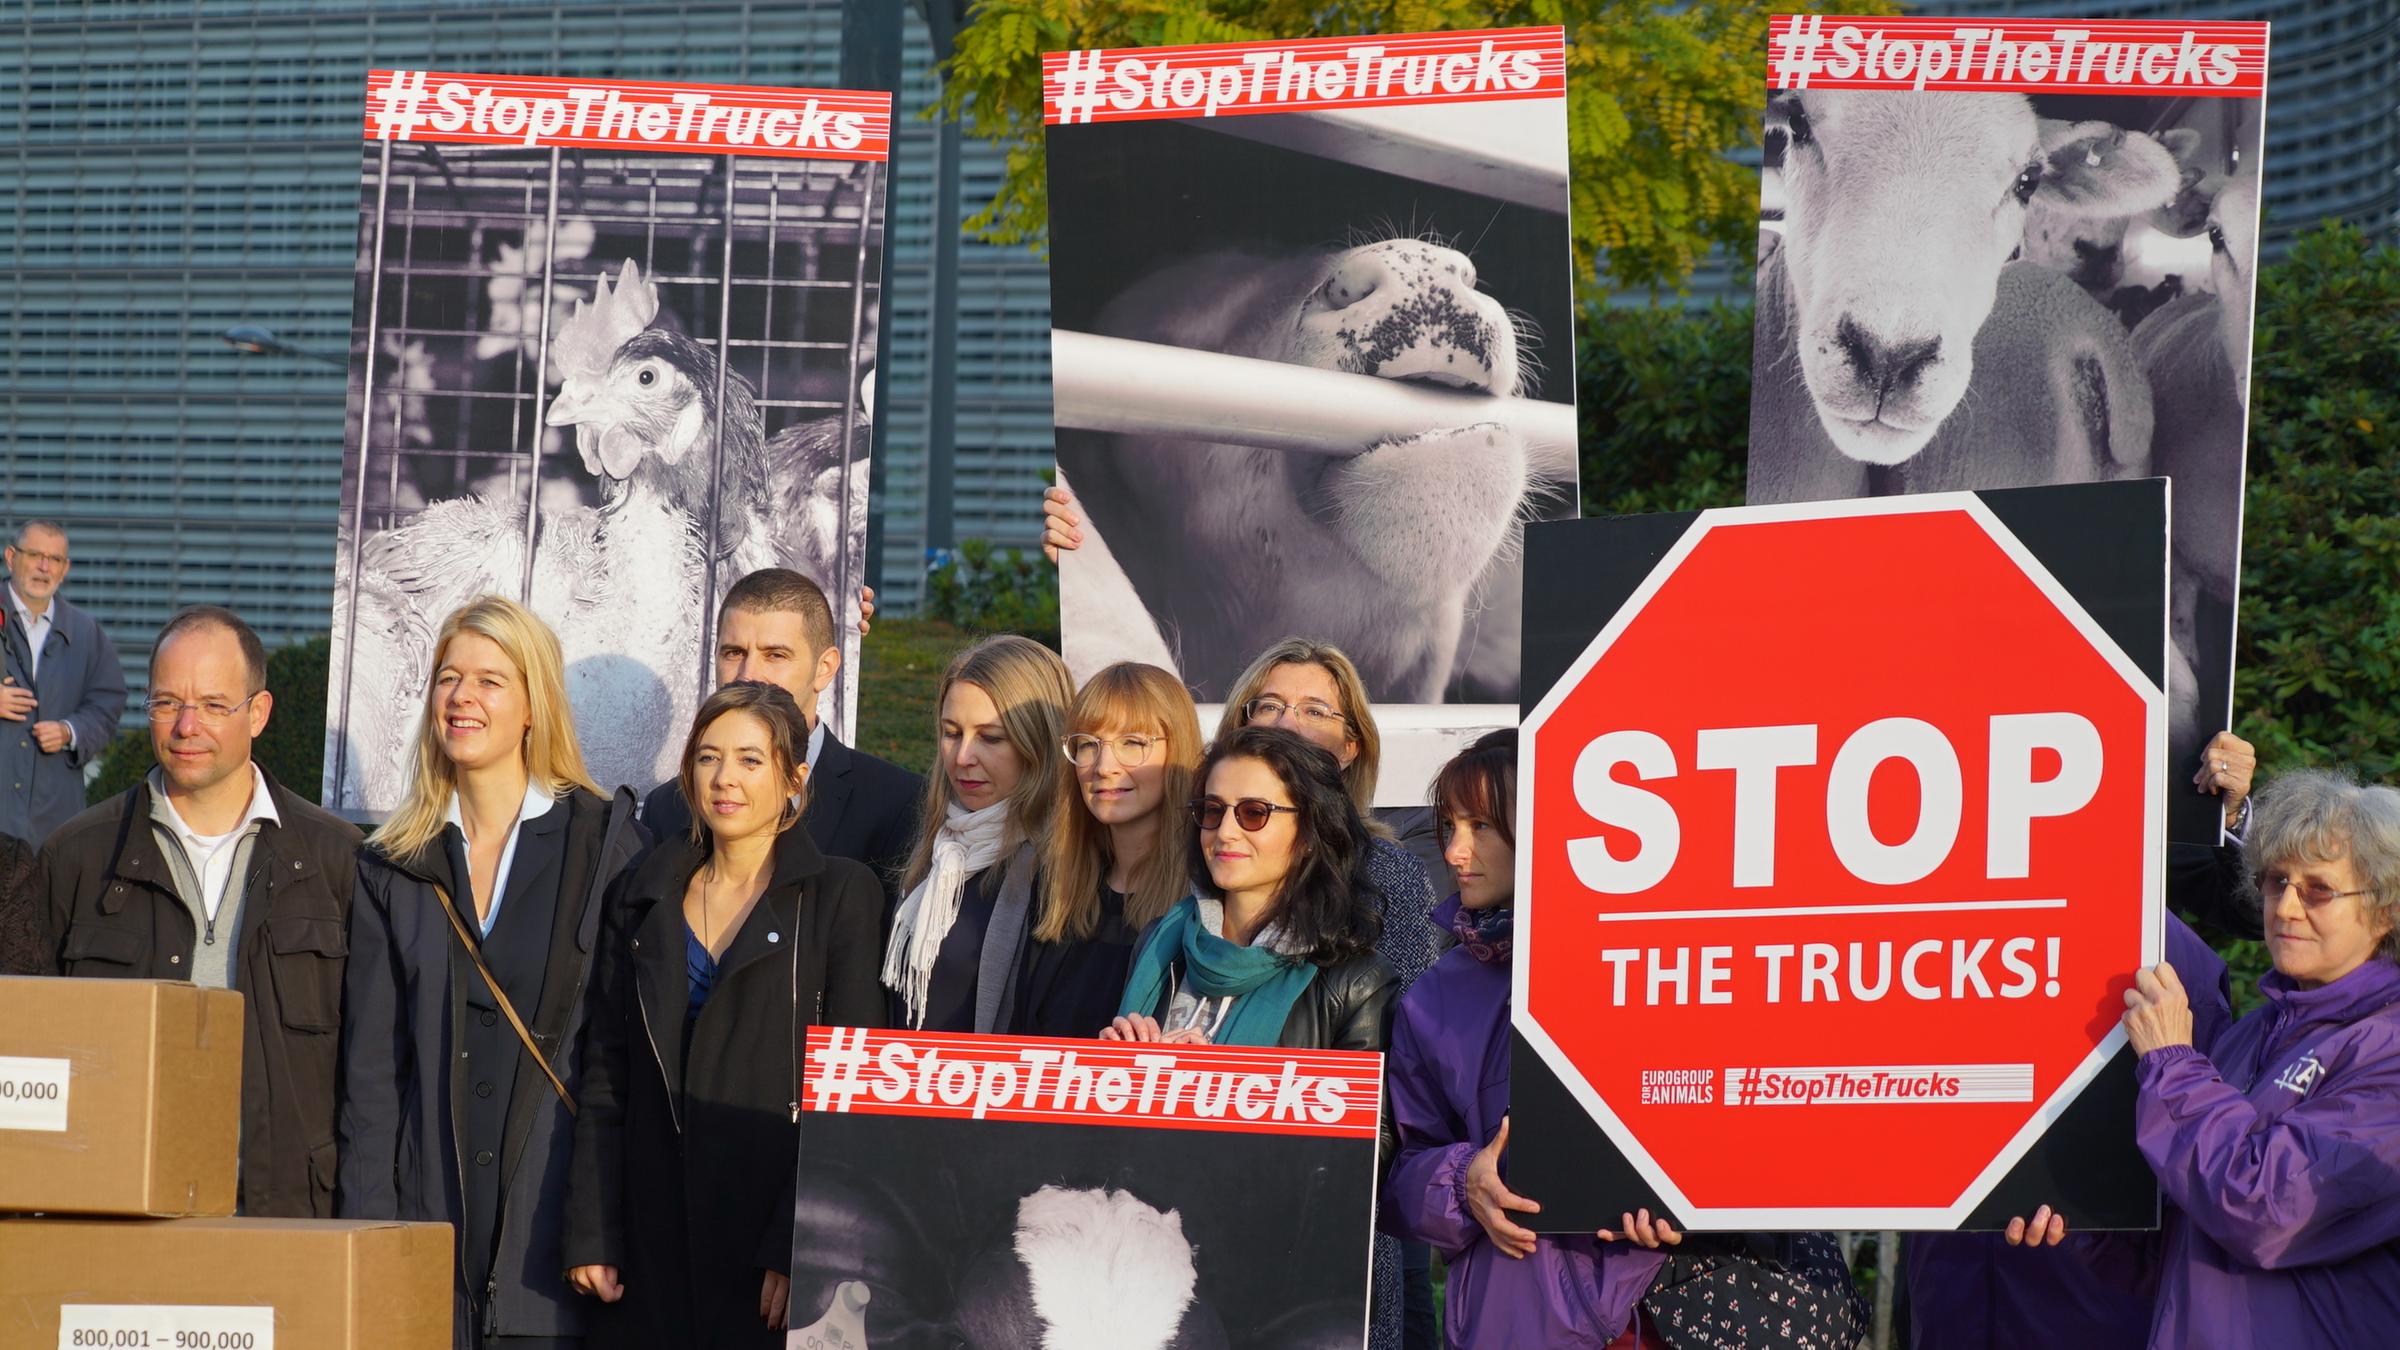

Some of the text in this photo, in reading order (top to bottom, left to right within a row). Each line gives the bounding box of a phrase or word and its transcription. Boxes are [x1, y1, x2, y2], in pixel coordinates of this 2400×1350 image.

[1055, 41, 1541, 124] #StopTheTrucks
[1775, 15, 2241, 91] #StopTheTrucks
[375, 70, 864, 149] #StopTheTrucks
[1566, 712, 2103, 894] STOP
[1601, 937, 2062, 1006] THE TRUCKS!
[0, 1080, 58, 1103] 0,000
[812, 1027, 1349, 1124] #StopTheTrucks
[1641, 1069, 1714, 1086] EUROGROUP
[1641, 1085, 1713, 1105] FOR ANIMALS
[1738, 1068, 1960, 1105] #StopTheTrucks
[72, 1328, 151, 1350] 800,001
[175, 1330, 254, 1350] 900,000
